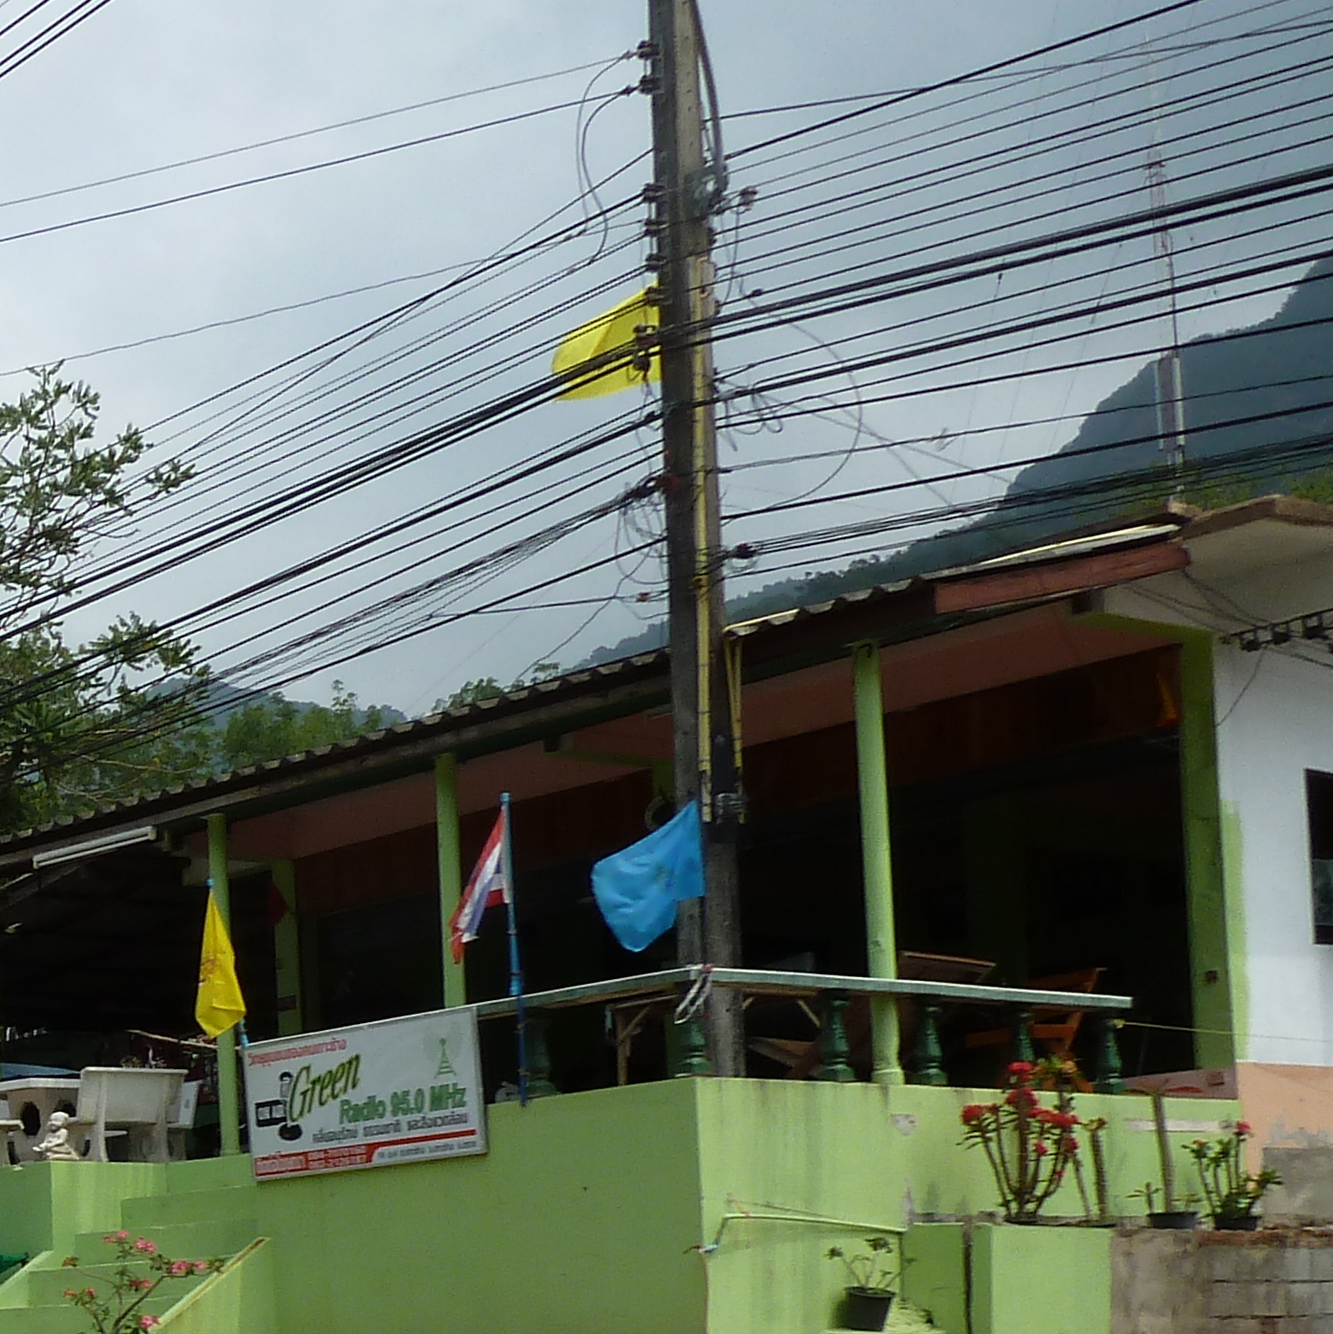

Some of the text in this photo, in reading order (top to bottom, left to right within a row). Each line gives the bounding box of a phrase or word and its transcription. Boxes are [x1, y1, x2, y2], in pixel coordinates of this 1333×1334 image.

[288, 1053, 362, 1123] Green
[339, 1095, 386, 1125] Radio
[428, 1082, 467, 1112] MHz
